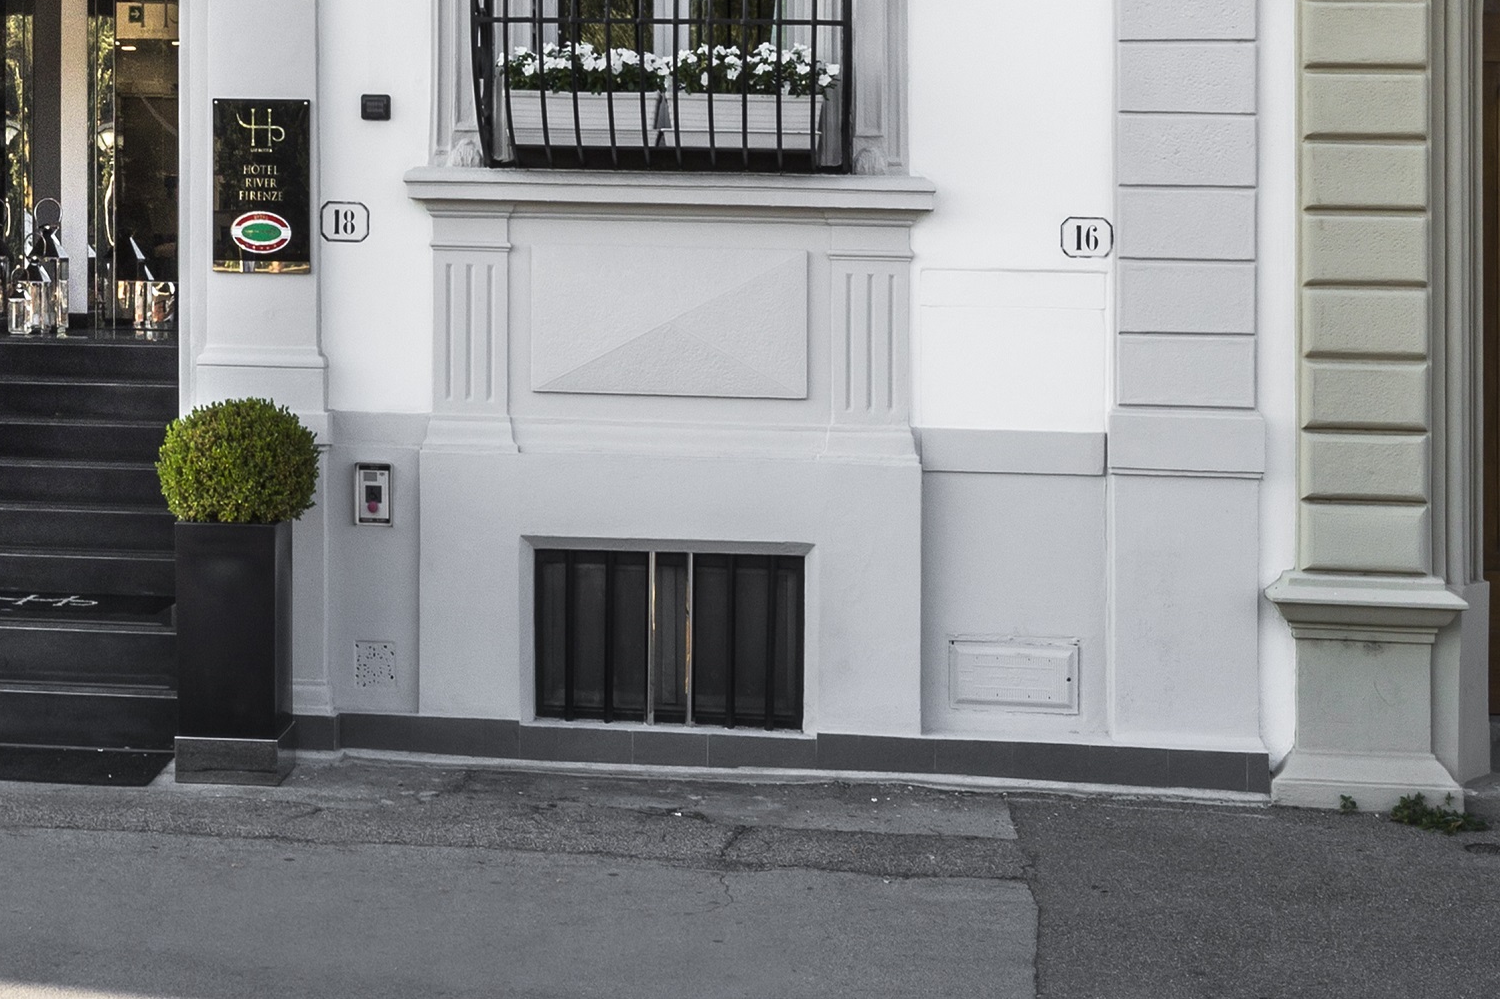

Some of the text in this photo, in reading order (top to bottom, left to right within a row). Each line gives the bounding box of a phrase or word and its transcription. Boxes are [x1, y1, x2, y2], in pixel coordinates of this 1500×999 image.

[243, 163, 279, 175] HOTEL
[245, 177, 278, 188] RIVER
[239, 190, 284, 201] FIRENZE
[334, 209, 356, 235] 18
[1075, 224, 1099, 252] 16
